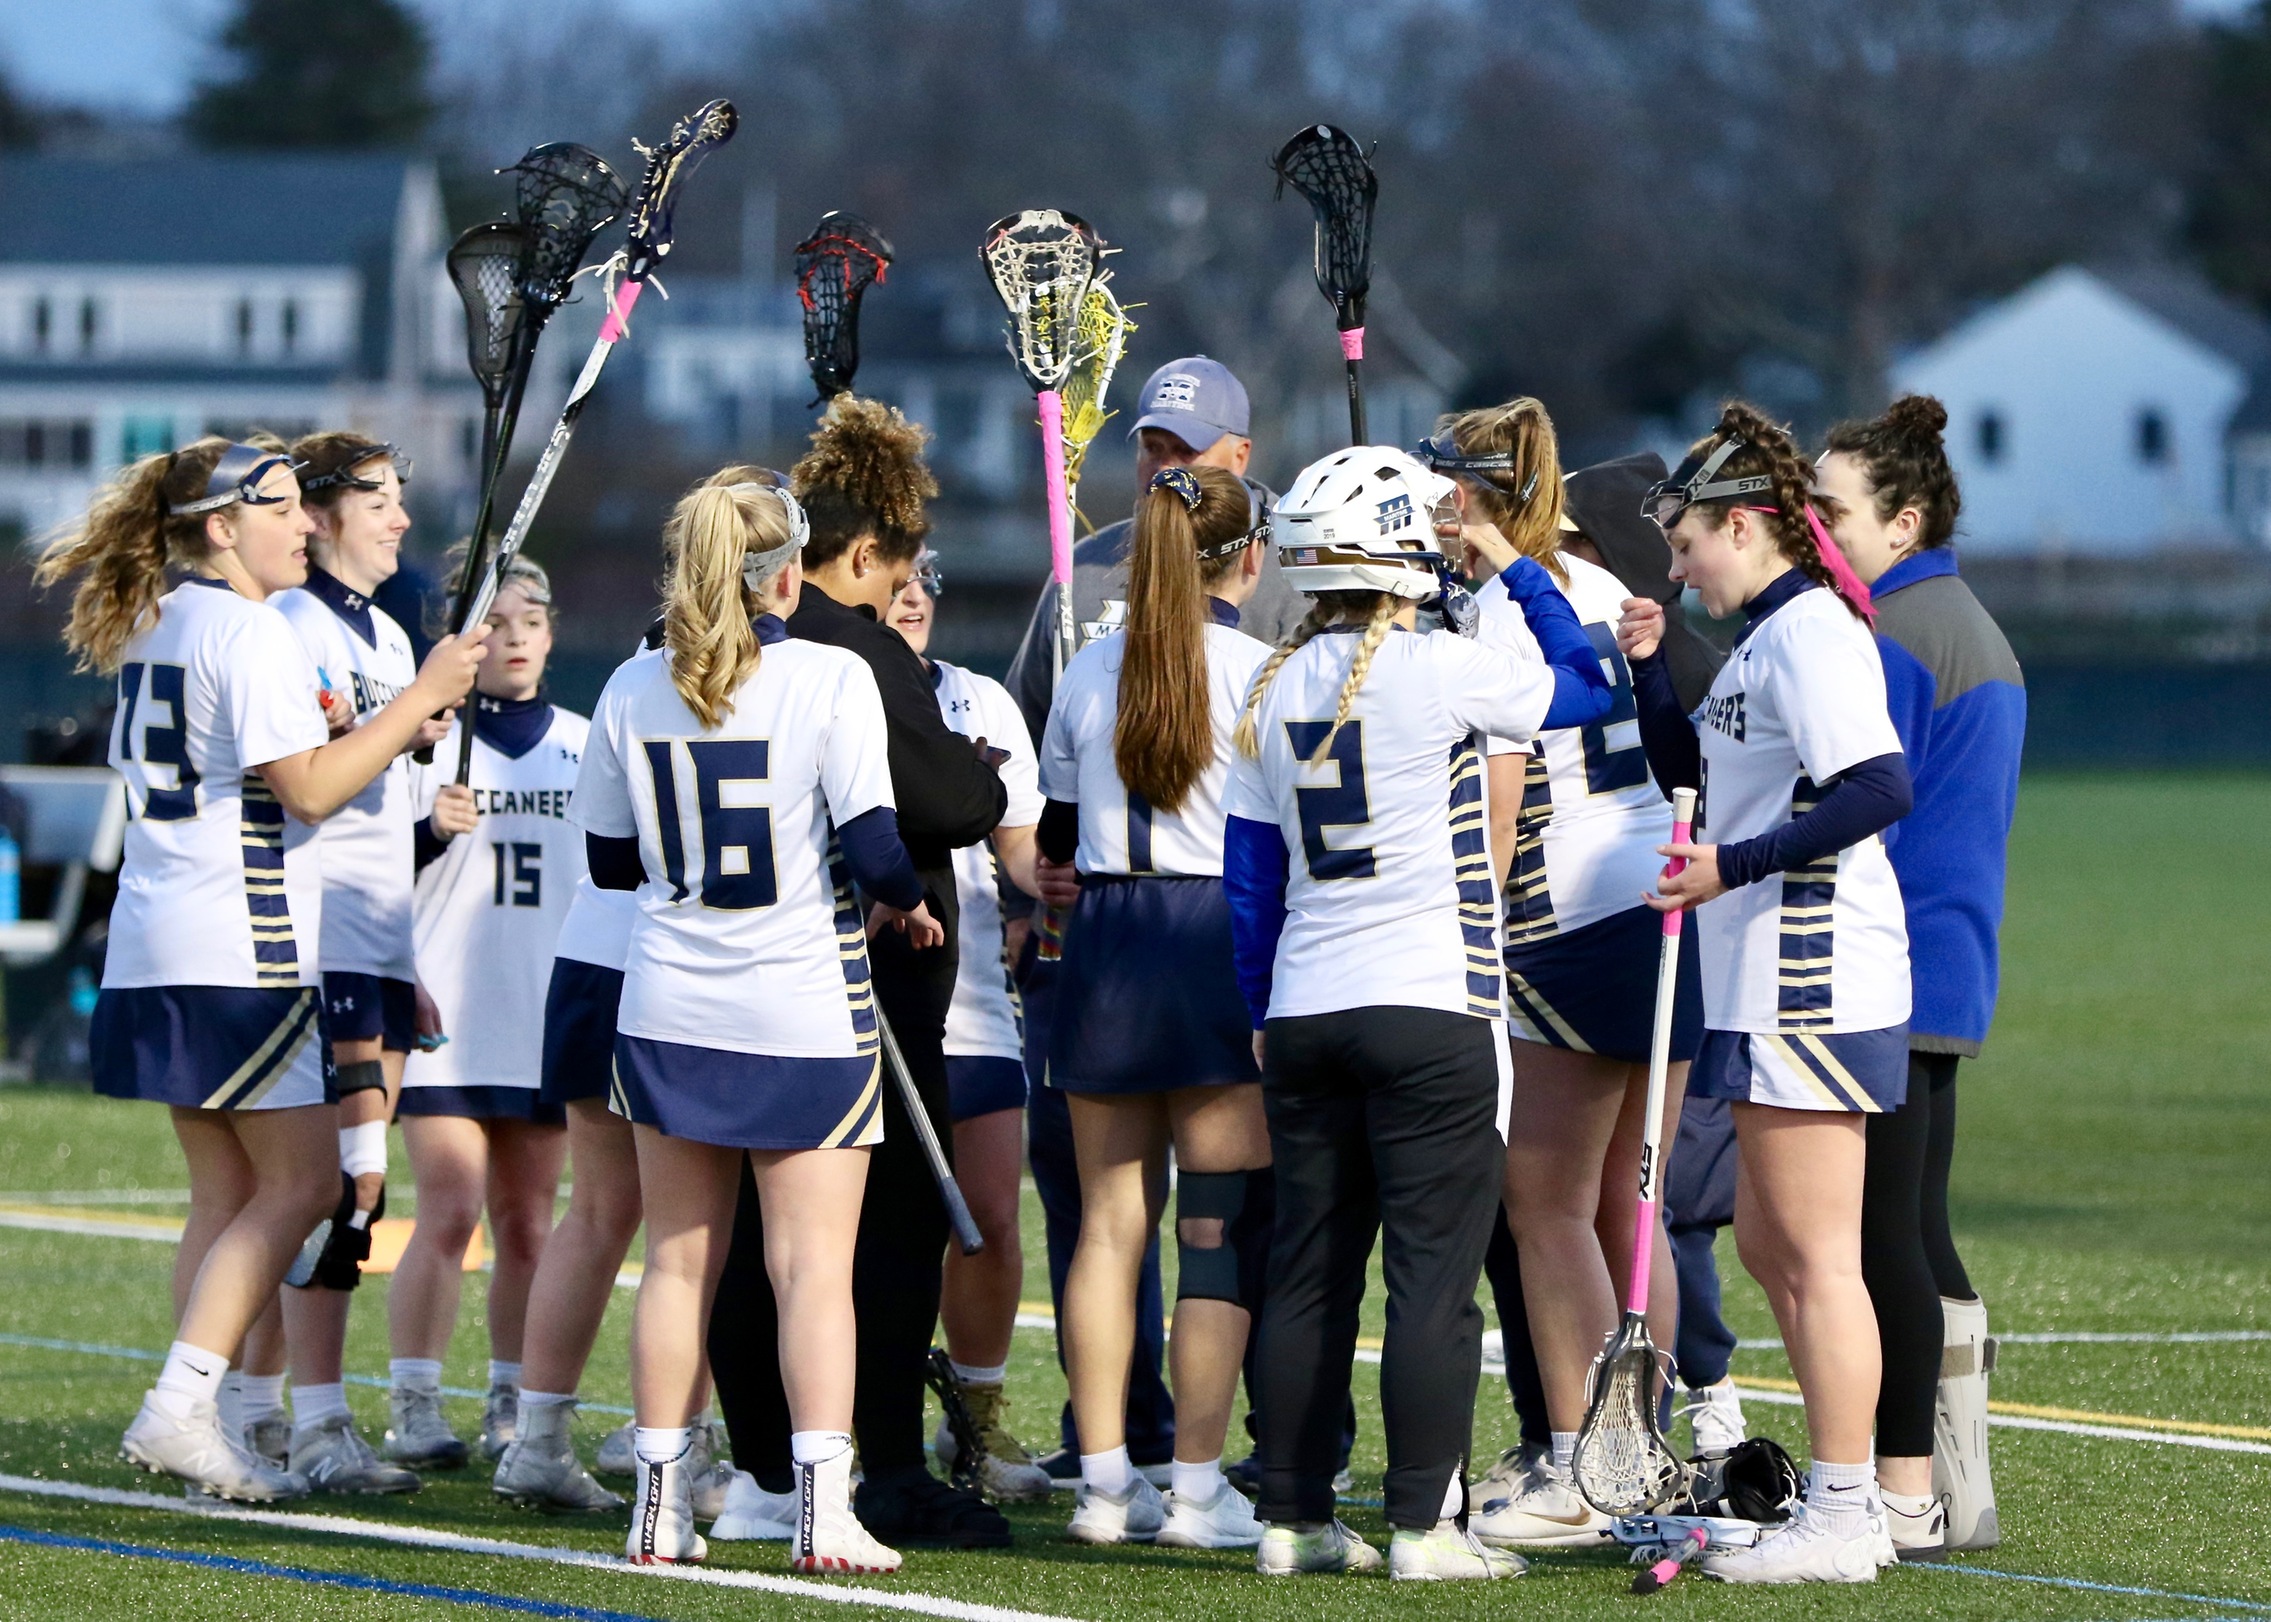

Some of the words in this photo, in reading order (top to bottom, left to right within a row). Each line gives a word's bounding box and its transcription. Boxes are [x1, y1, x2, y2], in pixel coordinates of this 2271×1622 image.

[1738, 477, 1769, 491] STX
[1220, 534, 1250, 555] STX
[1060, 604, 1074, 641] STX
[640, 737, 779, 912] 16
[1281, 717, 1379, 882] 2
[491, 842, 542, 907] 15
[1638, 1142, 1652, 1200] STX
[644, 1471, 660, 1539] HIGHLIGHT
[803, 1470, 812, 1539] HIGHLIGHT
